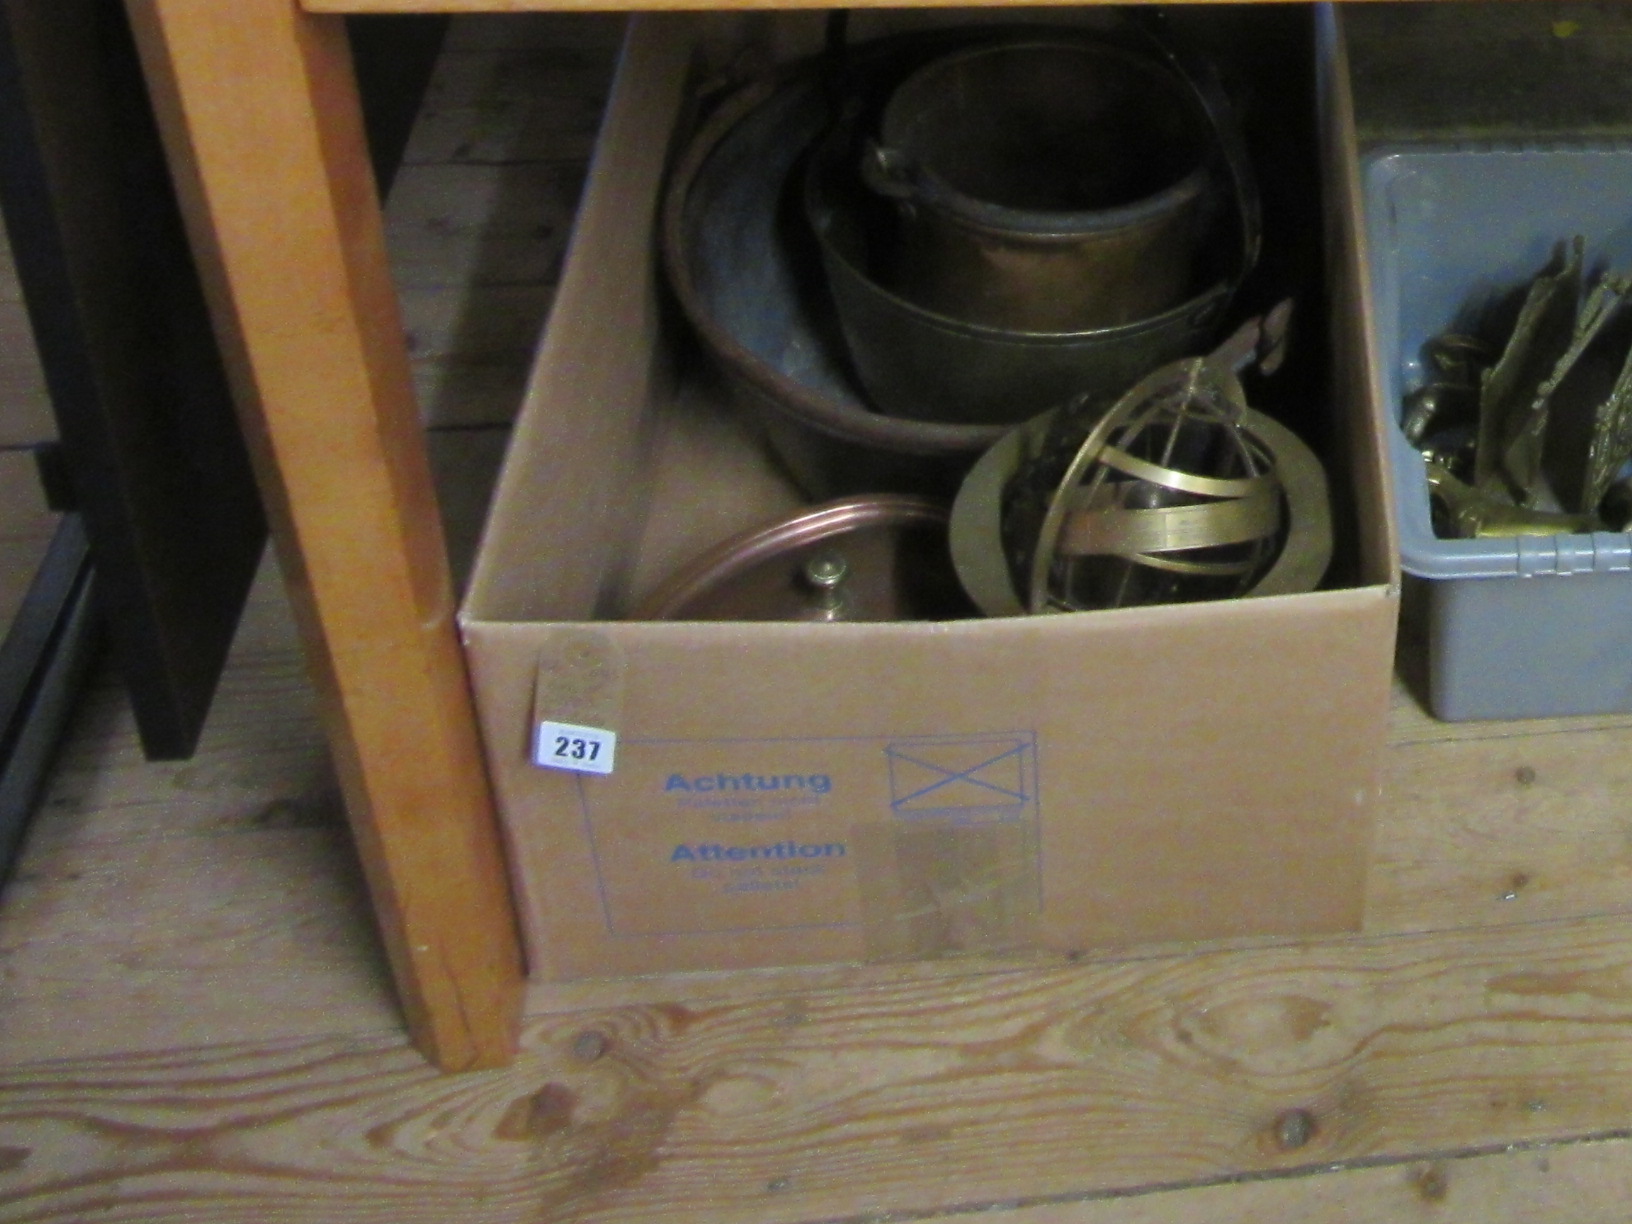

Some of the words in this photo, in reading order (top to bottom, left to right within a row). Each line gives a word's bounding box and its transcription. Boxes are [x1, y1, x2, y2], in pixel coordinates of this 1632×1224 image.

[555, 736, 602, 761] 237
[665, 773, 832, 794] Achtung
[671, 841, 847, 862] Attention
